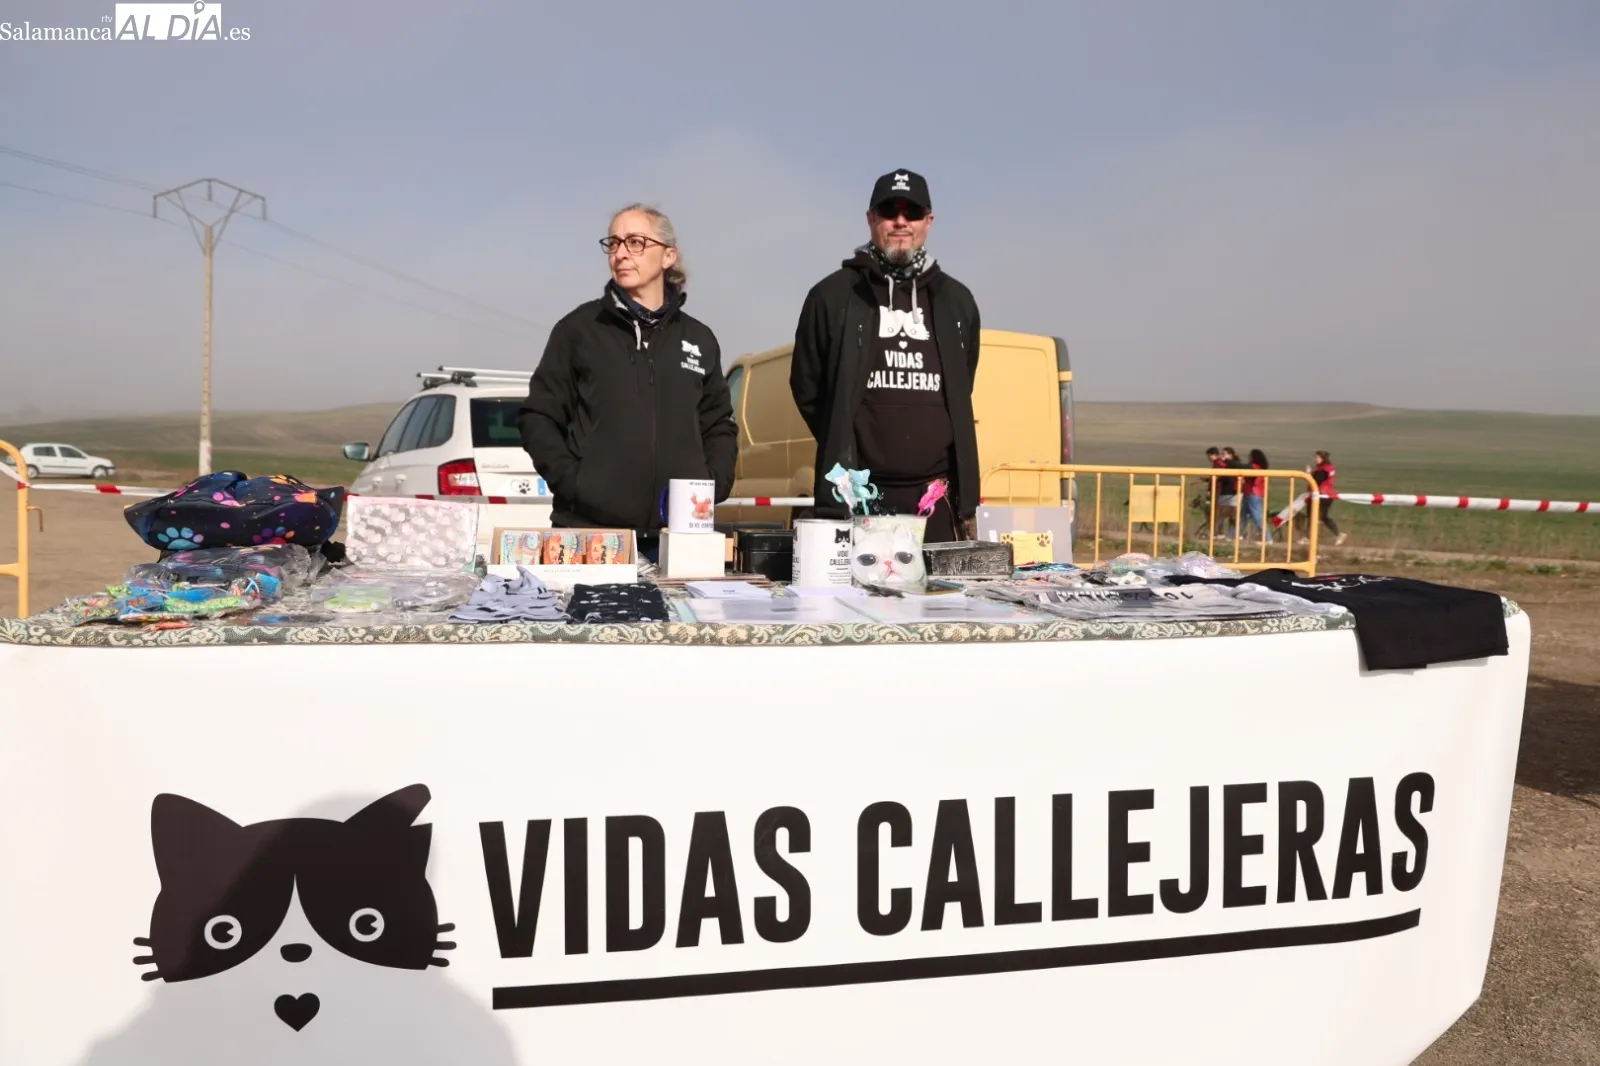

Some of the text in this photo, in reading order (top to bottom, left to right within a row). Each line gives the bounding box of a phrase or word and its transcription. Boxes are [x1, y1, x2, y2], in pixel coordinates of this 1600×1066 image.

[886, 350, 924, 369] VIDAS
[867, 370, 941, 392] CALLEJERAS
[479, 772, 1435, 958] VIDAS CALLEJERAS
